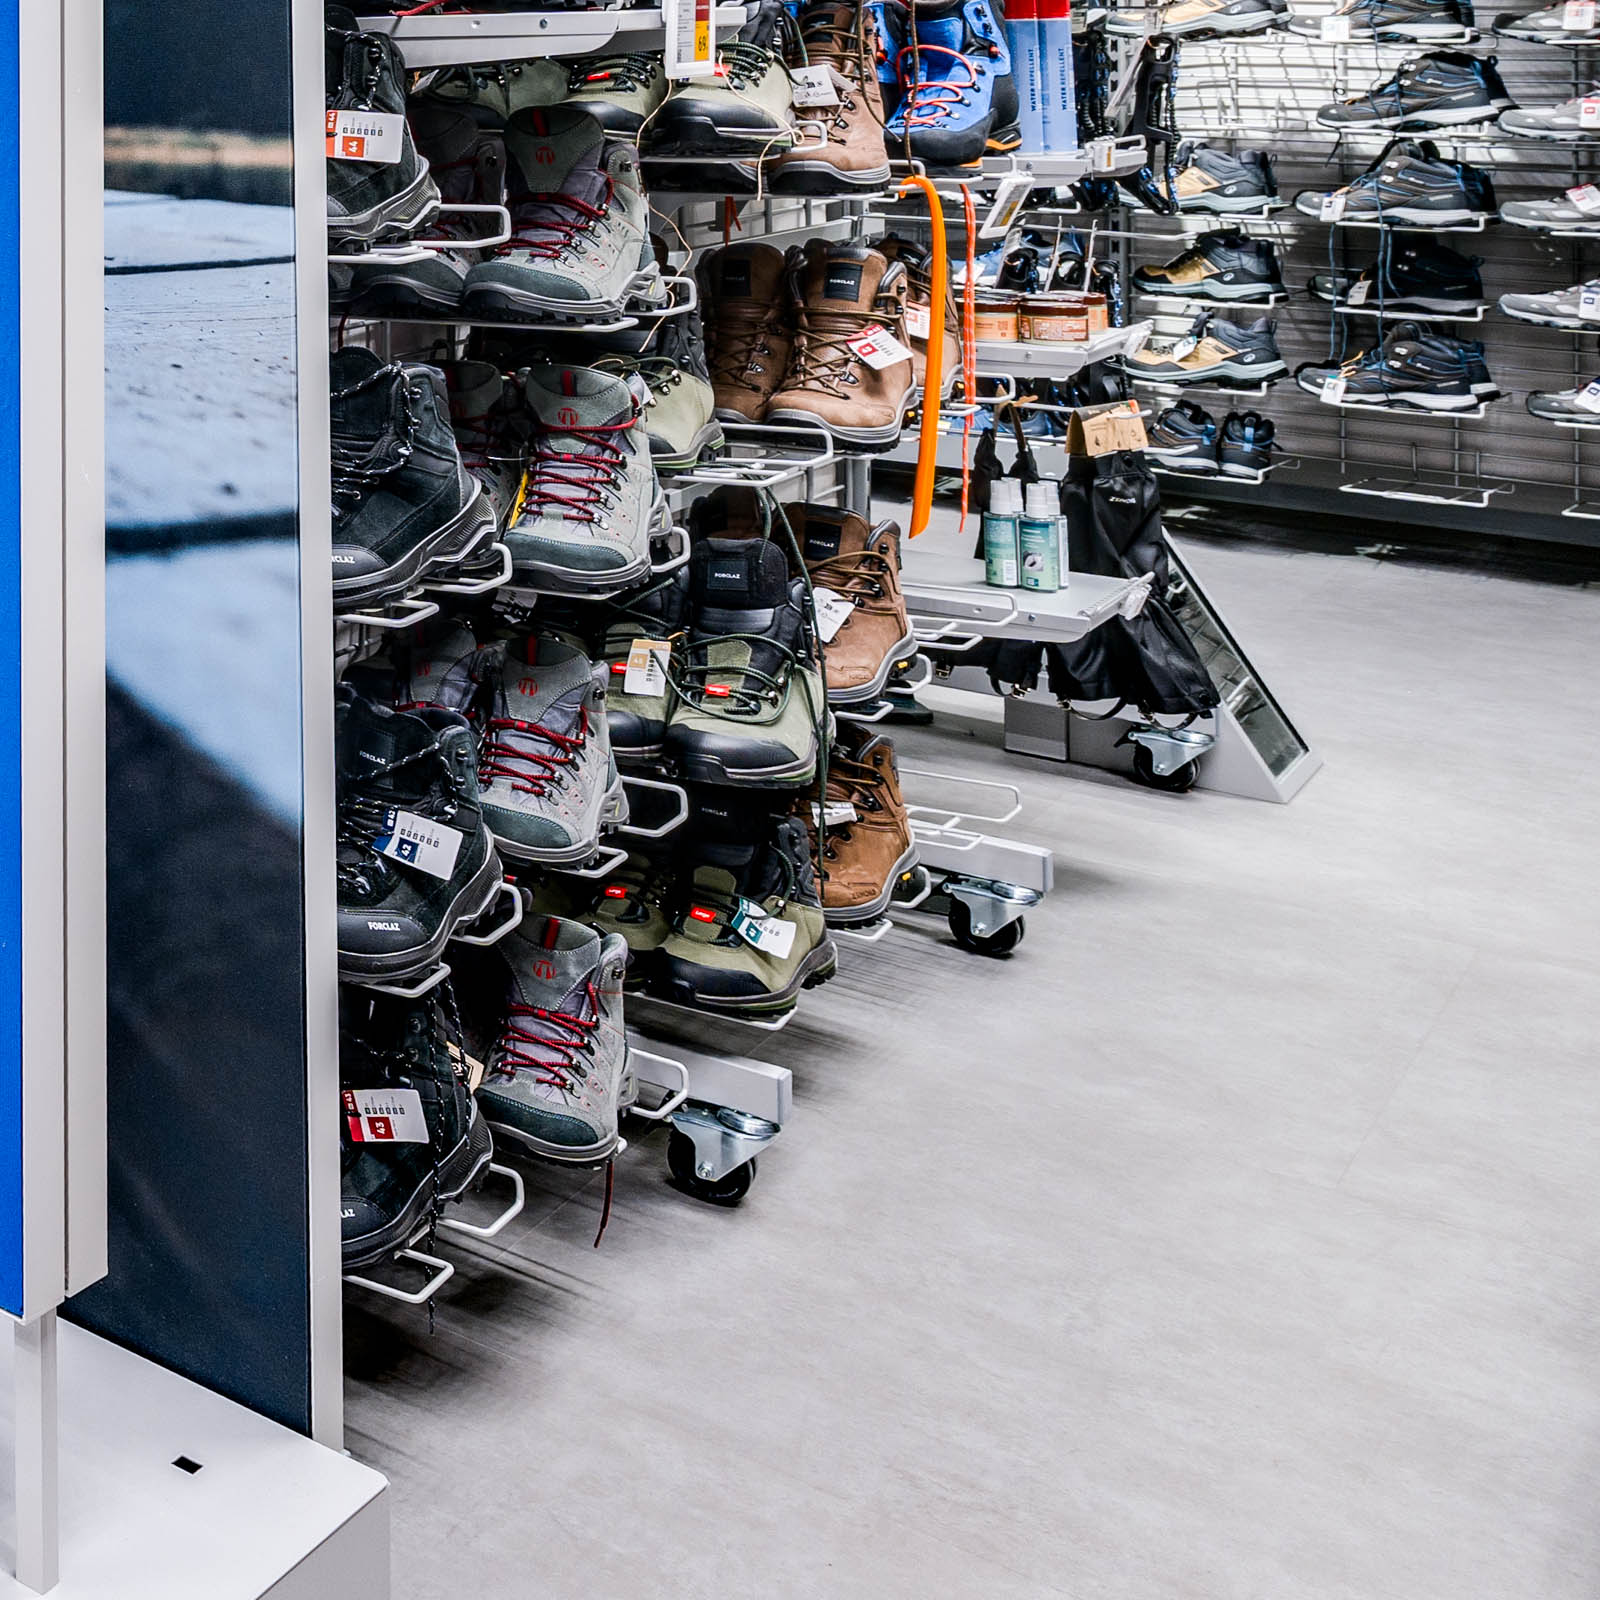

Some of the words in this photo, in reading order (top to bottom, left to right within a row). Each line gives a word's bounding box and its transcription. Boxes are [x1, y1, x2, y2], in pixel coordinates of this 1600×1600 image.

[348, 140, 358, 153] 44
[332, 556, 356, 564] CLAZ
[359, 750, 386, 765] FORCLAZ
[402, 844, 412, 856] 42
[368, 921, 400, 931] FORCLAZ
[375, 1121, 386, 1134] 43
